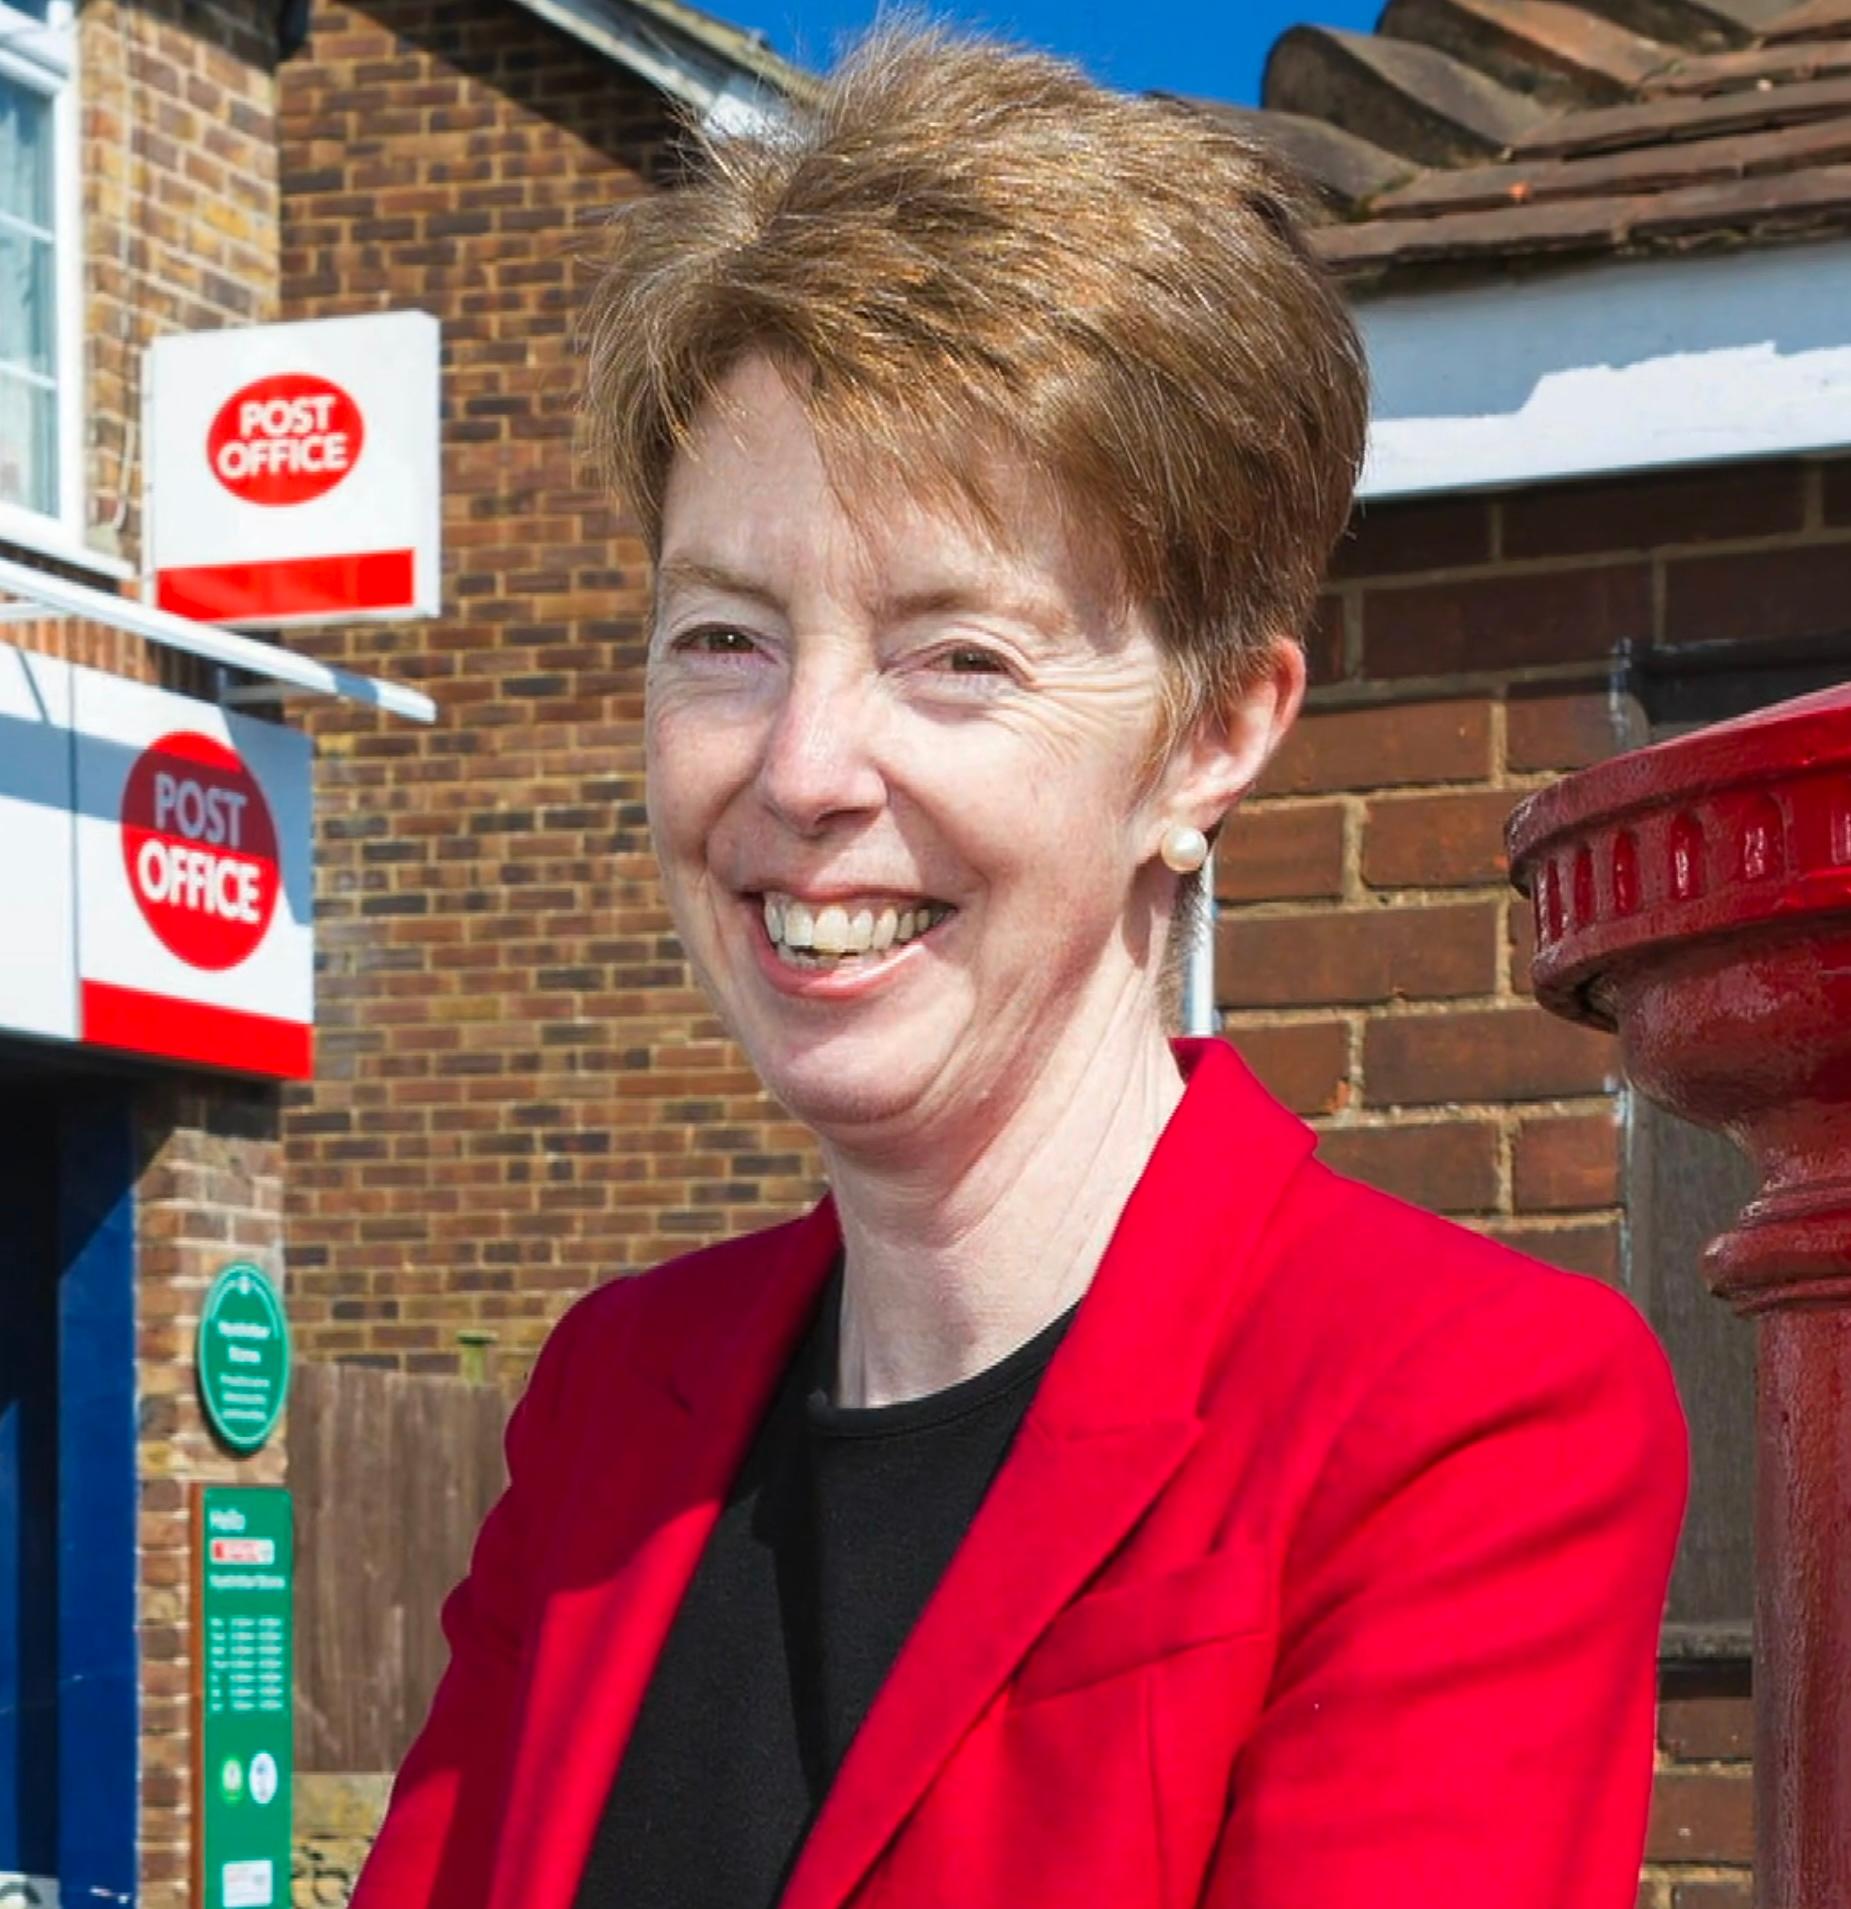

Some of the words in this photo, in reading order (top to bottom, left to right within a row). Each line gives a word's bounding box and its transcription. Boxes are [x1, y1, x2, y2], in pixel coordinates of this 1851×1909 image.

[239, 396, 336, 437] POST
[217, 433, 349, 479] OFFICE
[154, 774, 246, 848] POST
[138, 839, 260, 924] OFFICE
